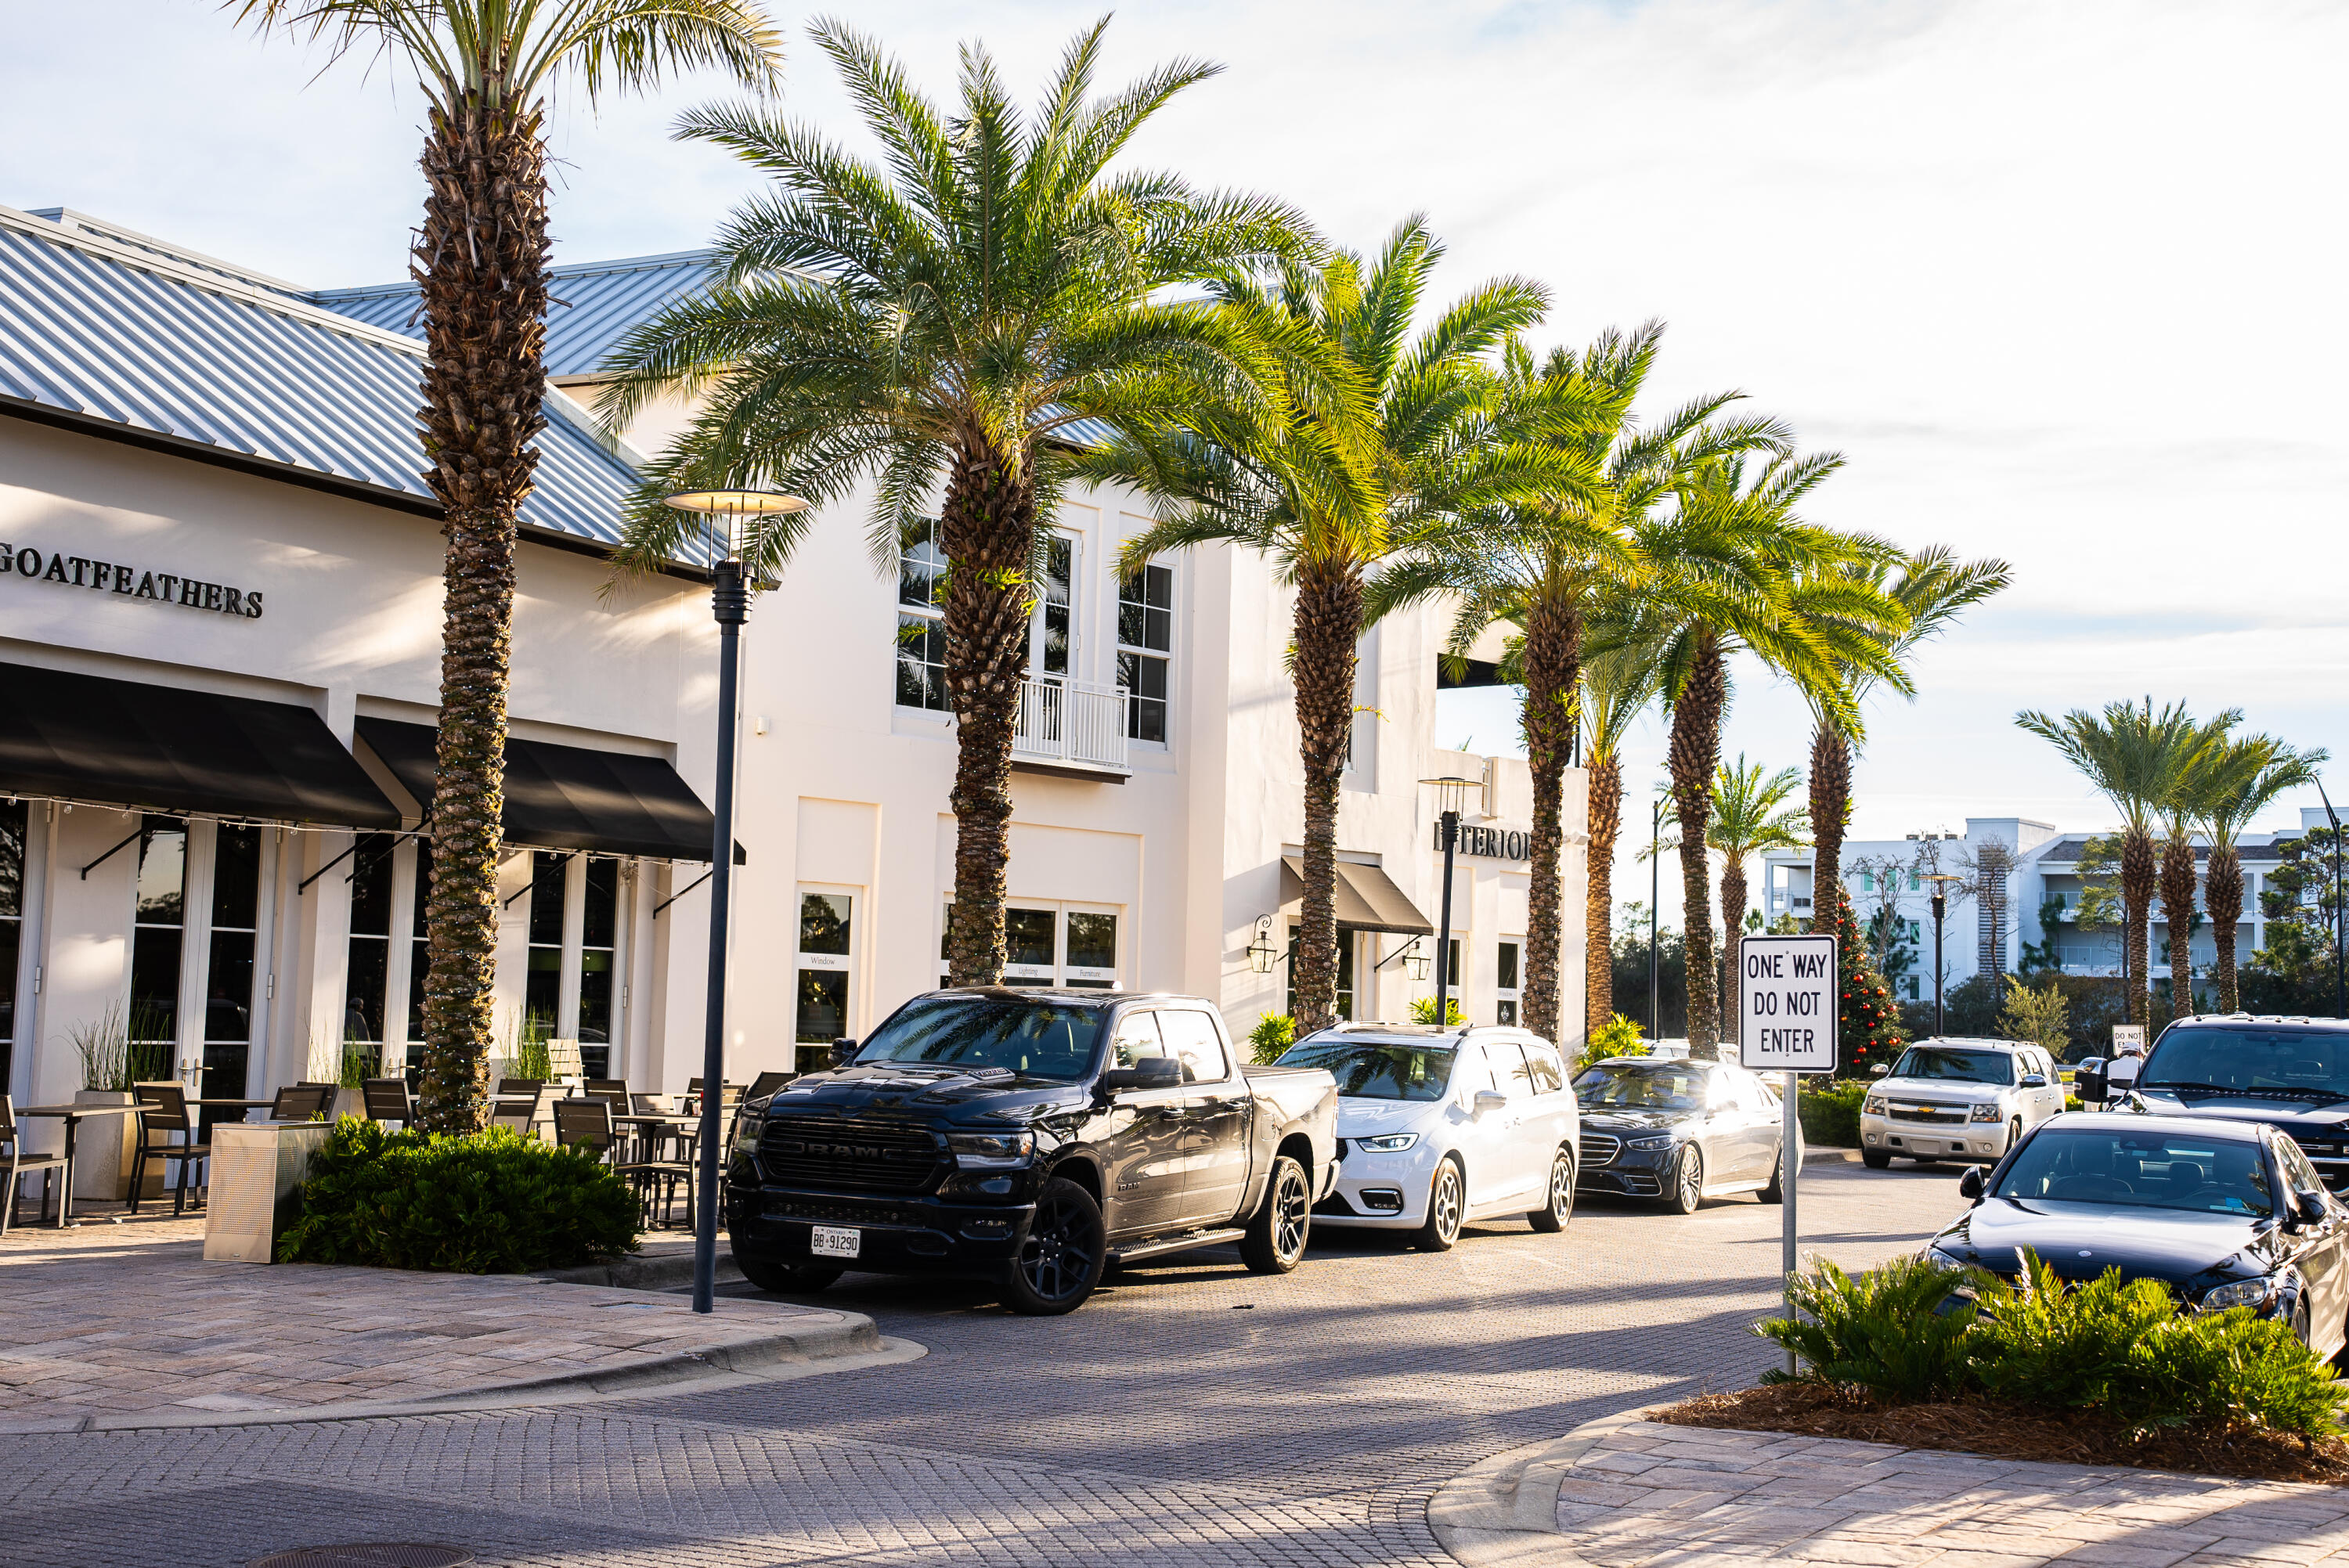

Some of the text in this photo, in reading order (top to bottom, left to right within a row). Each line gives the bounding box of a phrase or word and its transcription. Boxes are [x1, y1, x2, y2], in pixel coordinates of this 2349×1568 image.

[0, 542, 263, 618] GOATFEATHERS
[810, 957, 835, 965] Window
[1748, 953, 1828, 979] ONE WAY
[1019, 967, 1038, 977] Lighting
[1079, 969, 1101, 978] Furniture
[1754, 991, 1821, 1016] DO NOT
[1761, 1028, 1814, 1053] ENTER
[808, 1144, 879, 1158] RAM
[814, 1233, 858, 1251] BB 91290
